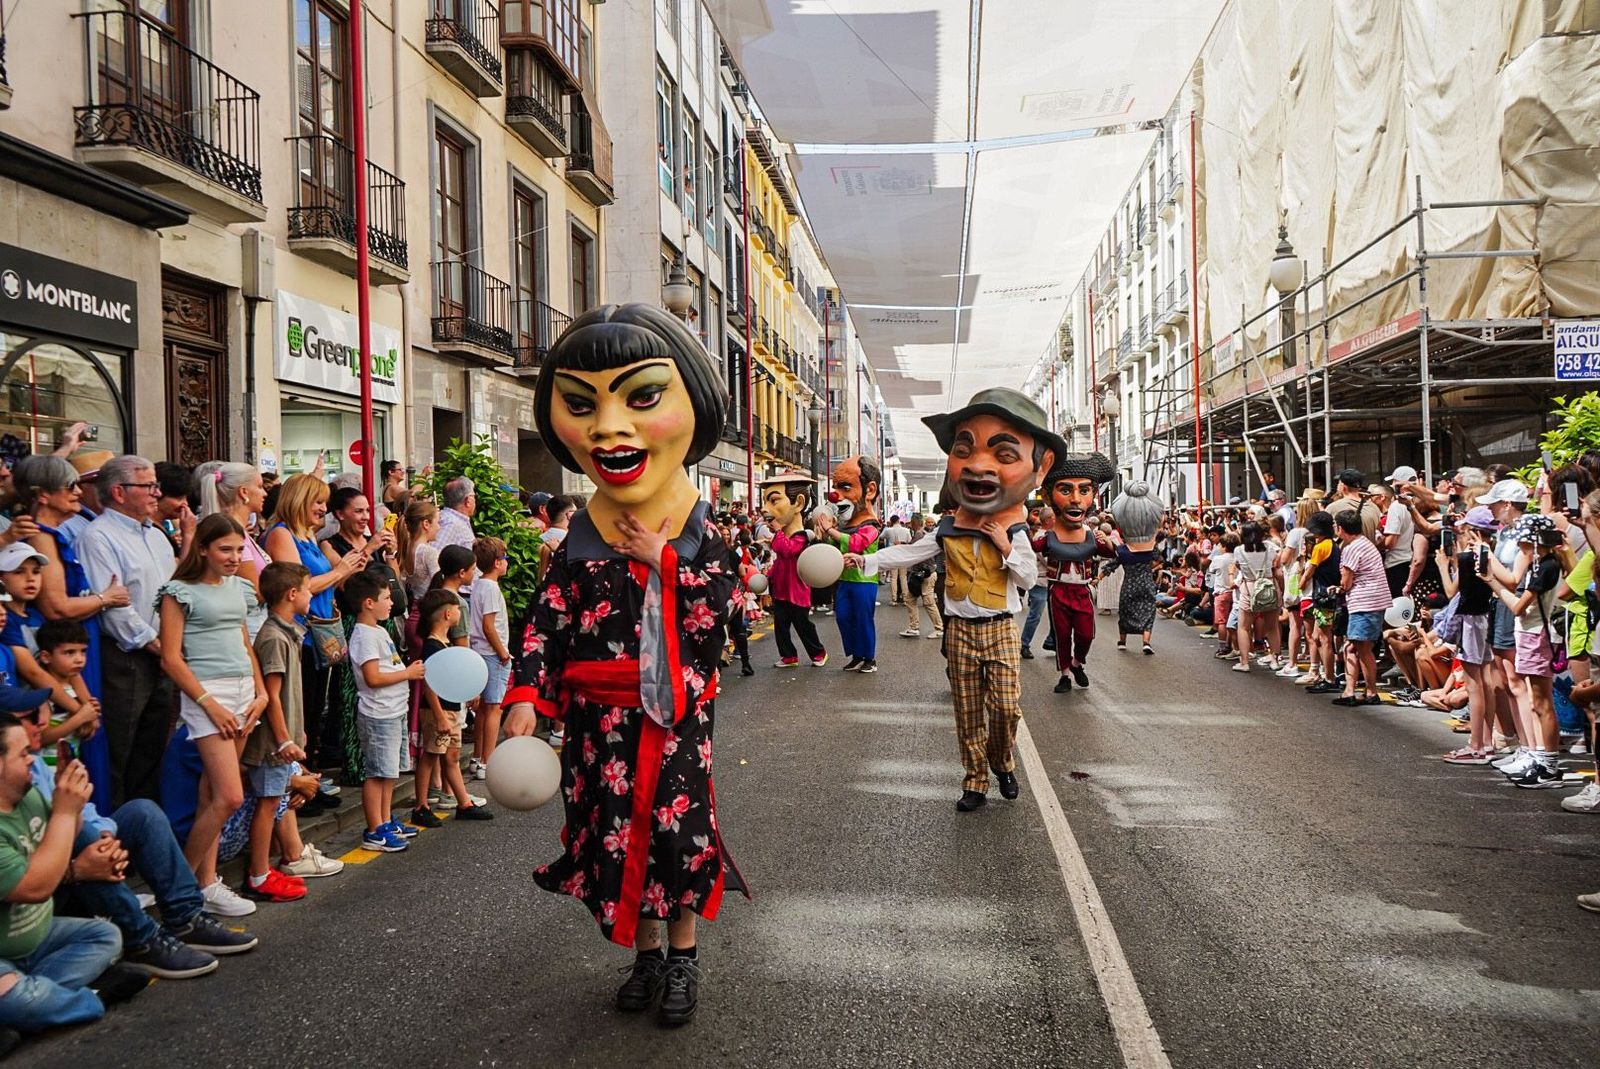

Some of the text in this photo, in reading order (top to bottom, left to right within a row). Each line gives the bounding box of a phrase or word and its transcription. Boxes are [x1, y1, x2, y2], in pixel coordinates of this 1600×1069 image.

[27, 279, 131, 323] MONTBLANC
[303, 325, 396, 378] Greenpone
[1557, 355, 1581, 370] 958
